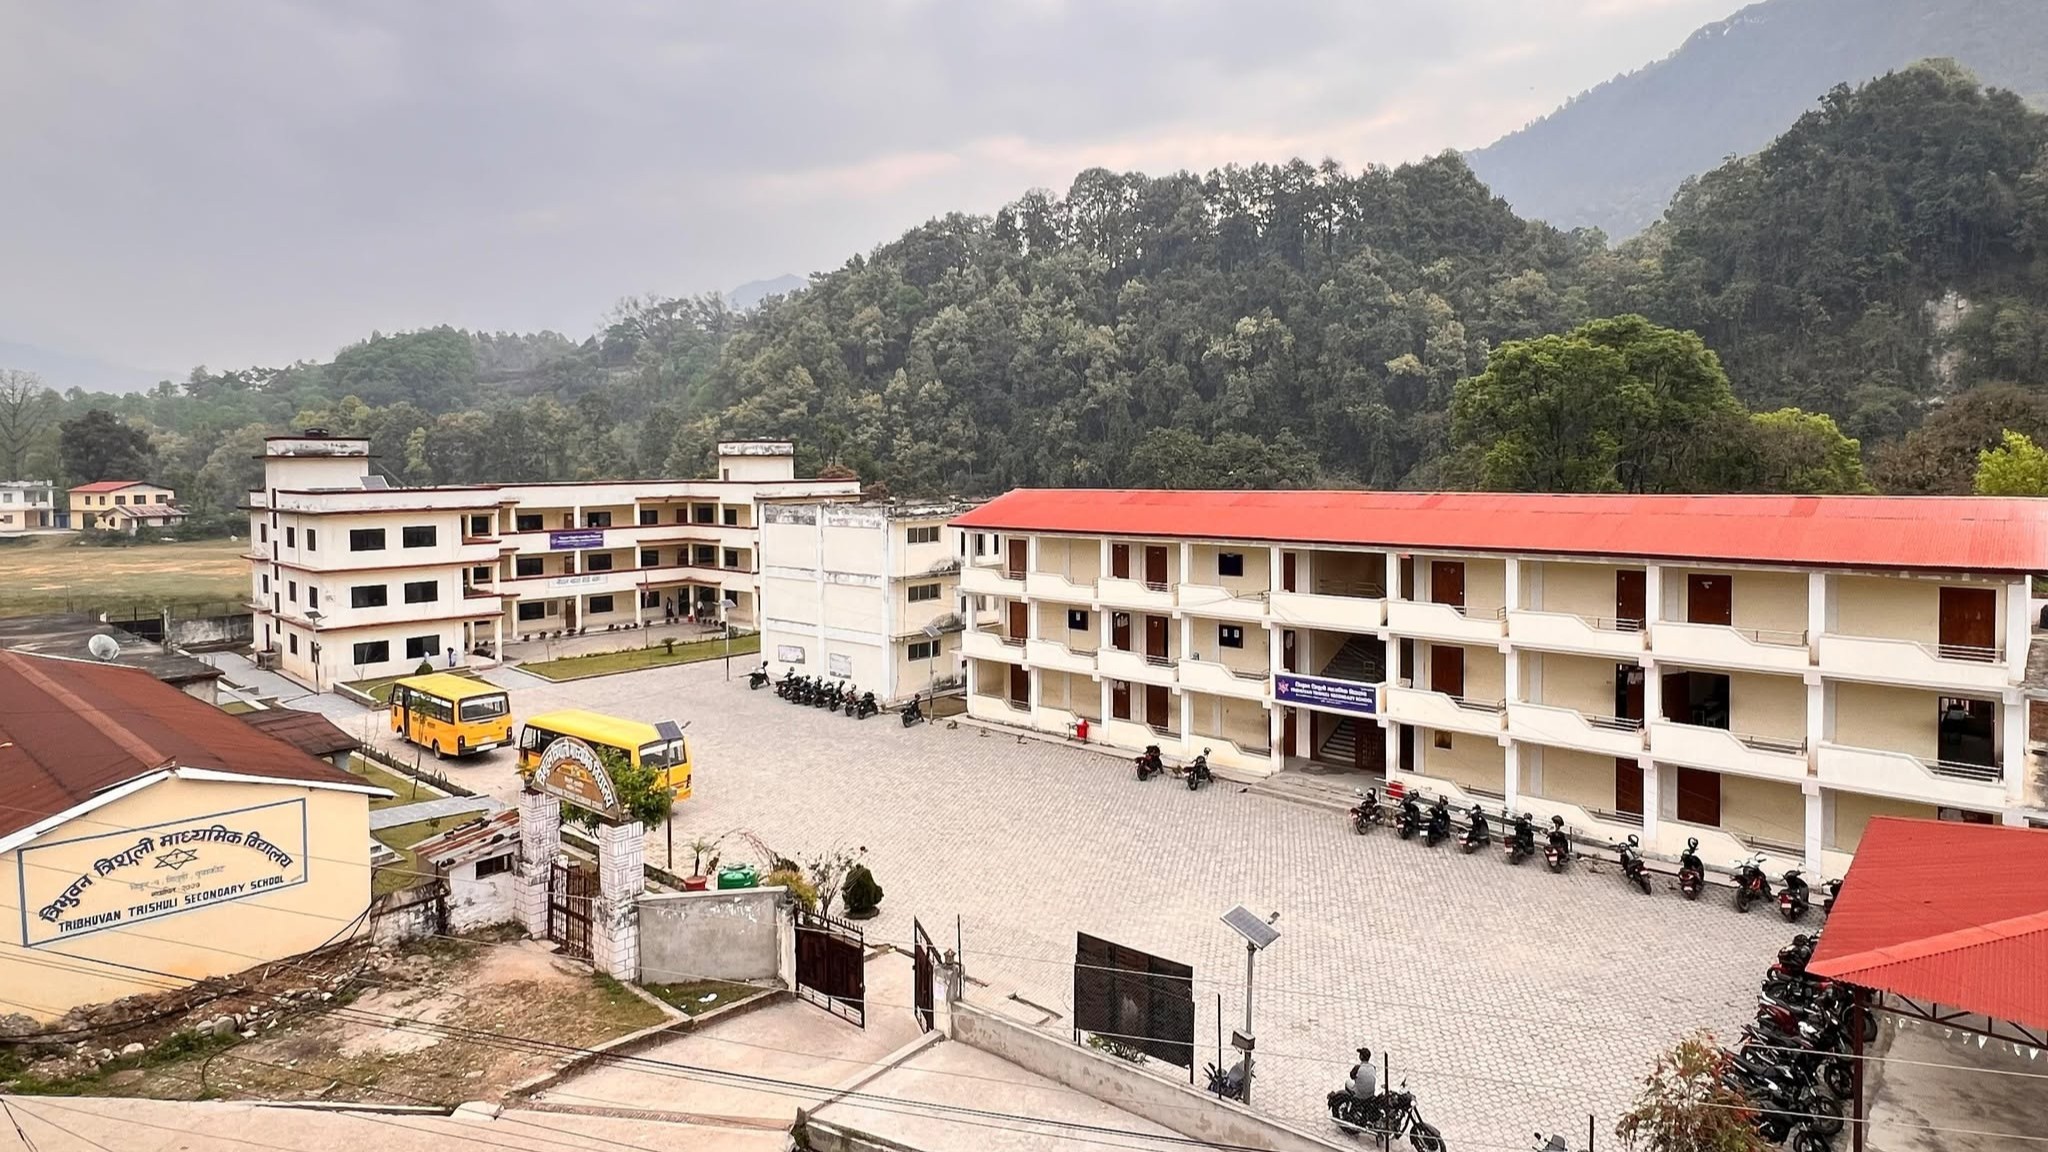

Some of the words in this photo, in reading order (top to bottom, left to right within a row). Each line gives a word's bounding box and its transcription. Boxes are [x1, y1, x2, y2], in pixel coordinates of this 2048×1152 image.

[38, 873, 93, 923] त्रिभुवन
[159, 824, 244, 848] माध्यमिक
[244, 831, 293, 868] विद्यालय
[58, 911, 121, 933] TRIBHUVAN
[128, 898, 178, 918] TRISHULI
[185, 883, 246, 905] SECONDARY
[250, 875, 285, 891] SCHOOL
